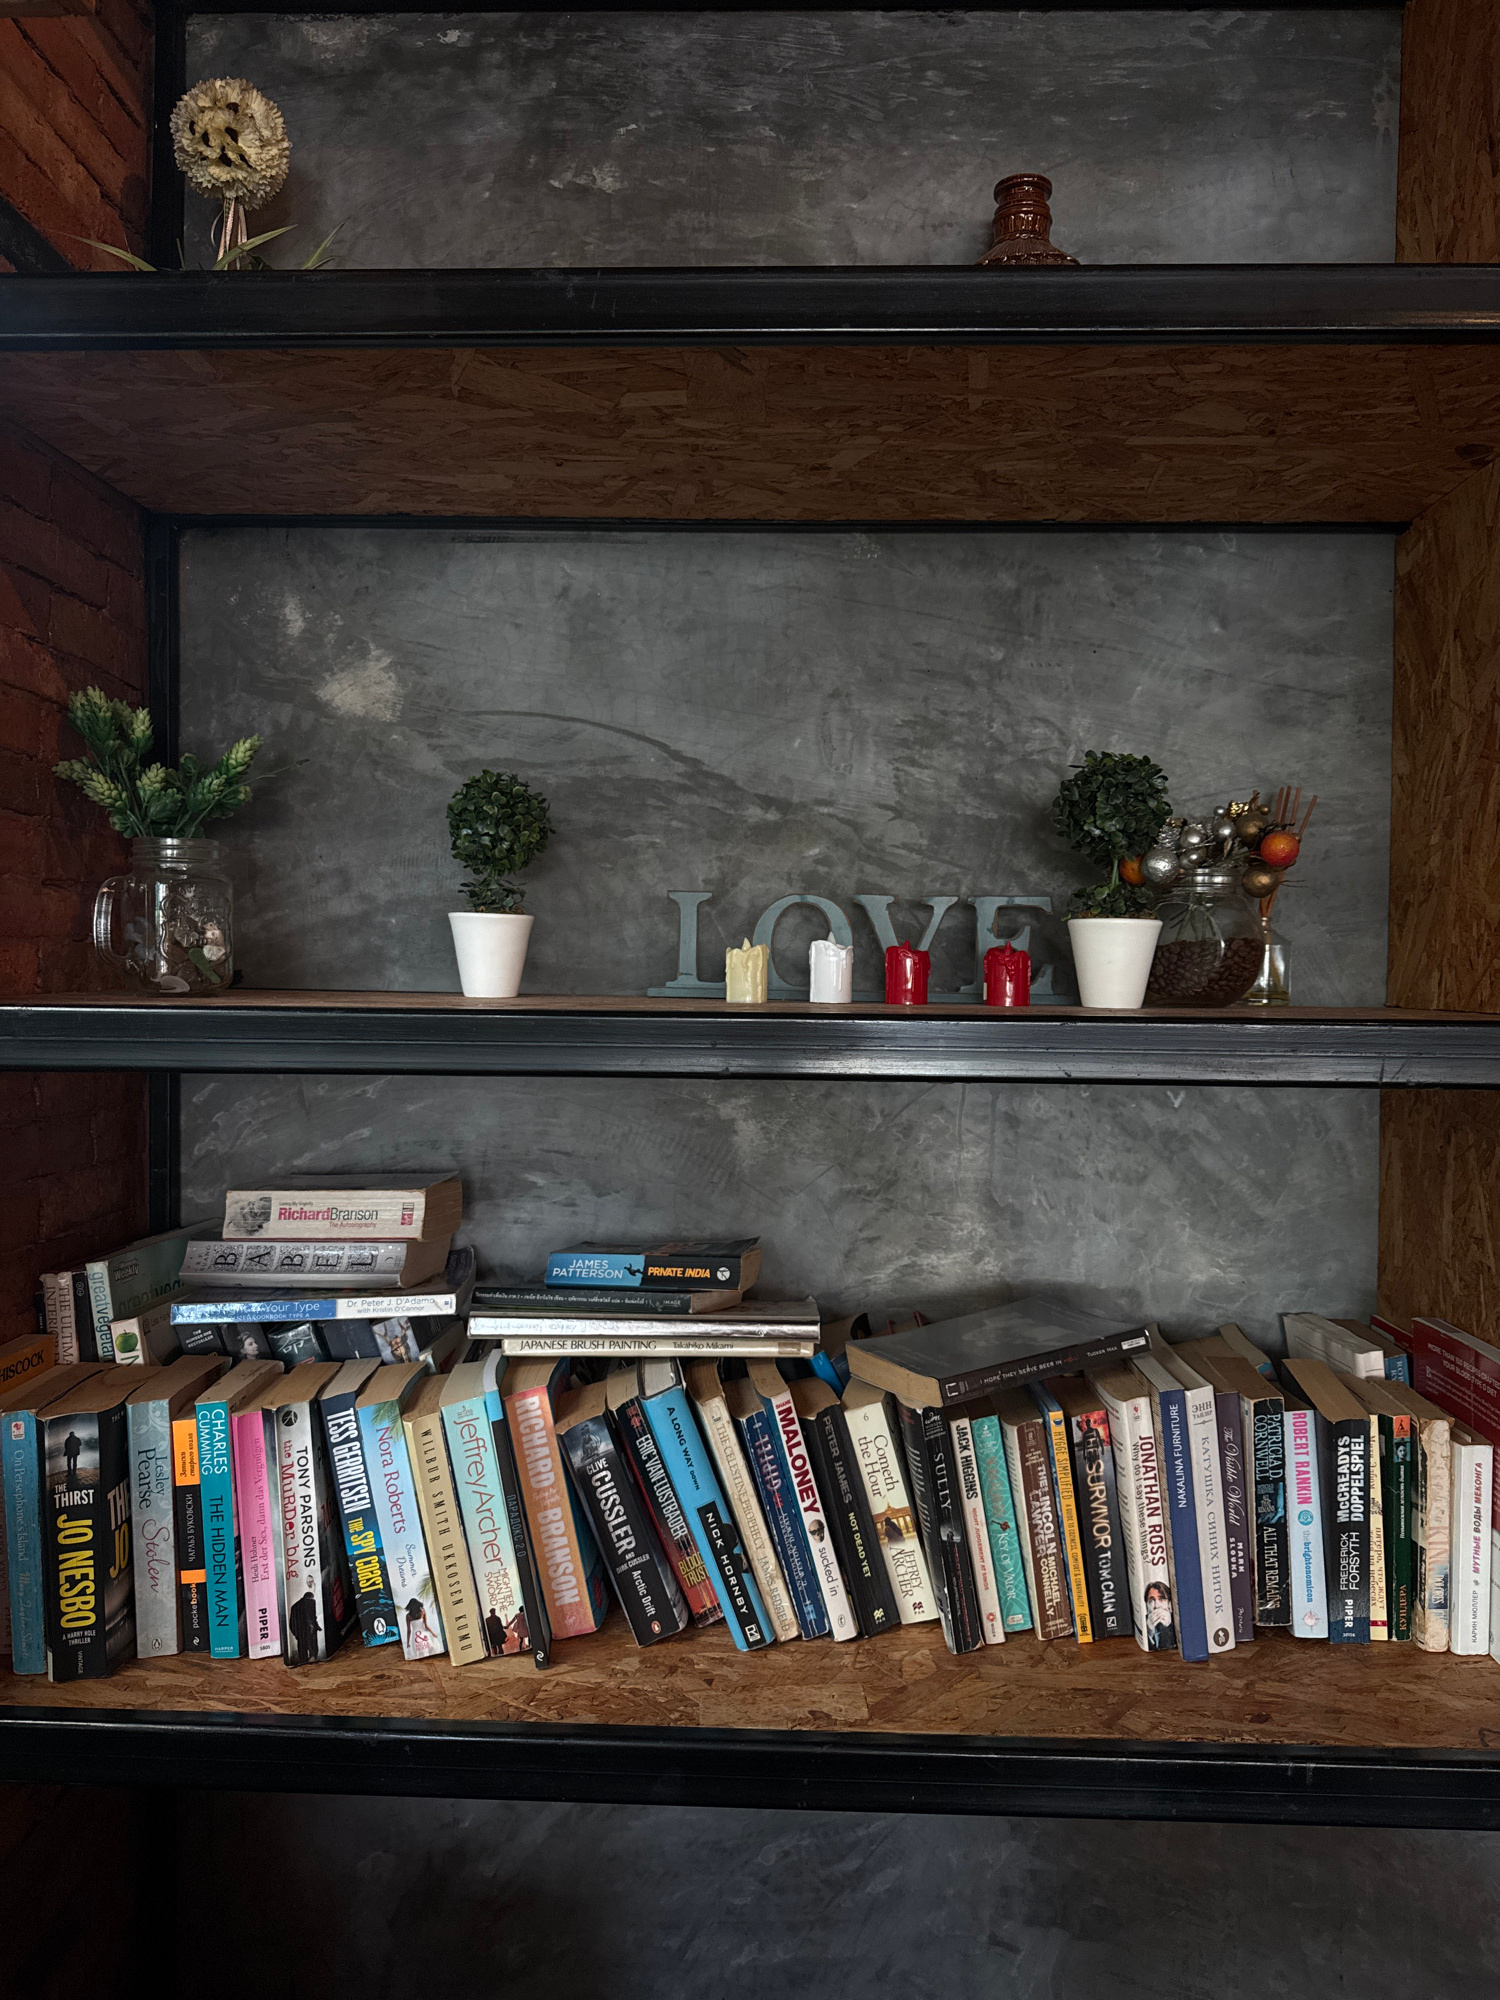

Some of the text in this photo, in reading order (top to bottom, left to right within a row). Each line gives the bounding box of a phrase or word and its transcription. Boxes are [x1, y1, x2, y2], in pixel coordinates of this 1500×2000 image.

[214, 1248, 376, 1268] BABEL
[552, 1267, 624, 1279] PATTERSON
[569, 1260, 609, 1270] JAMES
[648, 1267, 711, 1279] PRIVATE INDIA
[58, 1283, 72, 1314] THE
[293, 1301, 320, 1314] Type
[361, 1299, 386, 1308] Peter
[395, 1305, 425, 1313] O'Connor
[520, 1339, 657, 1351] JAPANESE BRUSH PAINTING
[672, 1341, 734, 1350] Takahiko Mikami
[1191, 1400, 1213, 1414] ЭНН
[198, 1410, 213, 1476] CUMMING
[211, 1408, 228, 1475] CHARLES
[283, 1439, 292, 1459] the
[327, 1407, 372, 1515] TESS GERRITSEN
[586, 1457, 609, 1475] CLIVE
[666, 1406, 701, 1491] A LONG WAY DOWN
[716, 1423, 748, 1499] THE CELESTINE
[778, 1405, 821, 1513] MALONEY
[822, 1415, 853, 1504] PETER JAMES
[857, 1435, 883, 1498] the Hour
[873, 1434, 900, 1492] Cometh
[955, 1424, 979, 1500] JACK HIGGINS
[1053, 1431, 1073, 1500] HYGGE SIMPLIFIED
[1168, 1403, 1187, 1508] NAKALINA FURNITURE
[1254, 1414, 1269, 1481] CORNWELL
[1267, 1413, 1284, 1470] PATRICIA
[1292, 1411, 1313, 1505] ROBERT RANKIN
[53, 1489, 95, 1509] THIRST
[54, 1483, 68, 1494] THE
[137, 1447, 157, 1510] Pearse
[154, 1455, 170, 1496] Lesley
[376, 1426, 407, 1534] Nora Roberts
[514, 1394, 556, 1489] RICHARD
[537, 1506, 581, 1607] BRANSON
[634, 1433, 656, 1462] ERIC
[652, 1477, 689, 1541] LUSTBADER
[933, 1451, 952, 1510] SULLY
[1086, 1459, 1112, 1549] SURVIVOR
[1132, 1441, 1147, 1529] Why do say these
[1138, 1435, 1166, 1567] JONATHAN ROSS
[1224, 1443, 1245, 1527] Visible World
[1336, 1435, 1351, 1523] McCREADYS
[1350, 1434, 1365, 1522] DOPPELSPIEL
[13, 1450, 29, 1562] On Persephone's Island
[185, 1493, 195, 1535] БУКОВСКИ
[296, 1445, 316, 1568] TONY PARSONS
[506, 1493, 520, 1542] ПАРАДОКС
[590, 1469, 637, 1556] CUSSLER
[1038, 1488, 1058, 1555] LINCOLN
[1200, 1436, 1224, 1615] КАТУШКА СИНИХ НИТОК
[1471, 1461, 1483, 1575] МУТНЫЕ ВОДЫ МЕКОНГА
[109, 1522, 130, 1579] JO
[141, 1518, 171, 1594] Stolen
[209, 1494, 229, 1627] THE HIDDEN MAN
[350, 1530, 377, 1556] SPY
[405, 1543, 418, 1578] Summer
[420, 1428, 473, 1651] WILBUR SMITH UKKOSEN KUMU
[705, 1512, 749, 1614] NICK HORNBY
[848, 1511, 872, 1579] NOT DEAD YET
[973, 1526, 985, 1563] JUDGEMENT
[1229, 1537, 1238, 1579] SLOUKA
[1237, 1542, 1245, 1573] MARK
[1263, 1526, 1278, 1545] ALL
[1264, 1544, 1278, 1570] THAT
[1340, 1532, 1349, 1591] FREDERICK
[1349, 1531, 1360, 1590] FORSYTH
[57, 1514, 97, 1629] JO NESBO
[395, 1556, 408, 1589] Dreams
[484, 1571, 499, 1606] SWORD
[501, 1567, 515, 1606] MIGHTIER
[632, 1569, 656, 1617] Arctic Drift
[818, 1547, 839, 1597] sucked in
[889, 1546, 915, 1599] ARCHER
[905, 1549, 924, 1590] JEFFREY
[996, 1532, 1016, 1600] KEY VALOR
[1040, 1558, 1055, 1616] CONNELLY
[1046, 1553, 1061, 1607] MICHAEL
[1098, 1550, 1117, 1614] TOM CAIN
[1264, 1570, 1282, 1609] REMAINS
[258, 1607, 269, 1641] PIPER
[1344, 1599, 1354, 1628] PIPER
[1399, 1584, 1407, 1631] КУНДЕРА
[1472, 1589, 1480, 1620] МЮЛЛЕР
[67, 1631, 84, 1640] HARRY
[68, 1636, 92, 1646] THRILLER
